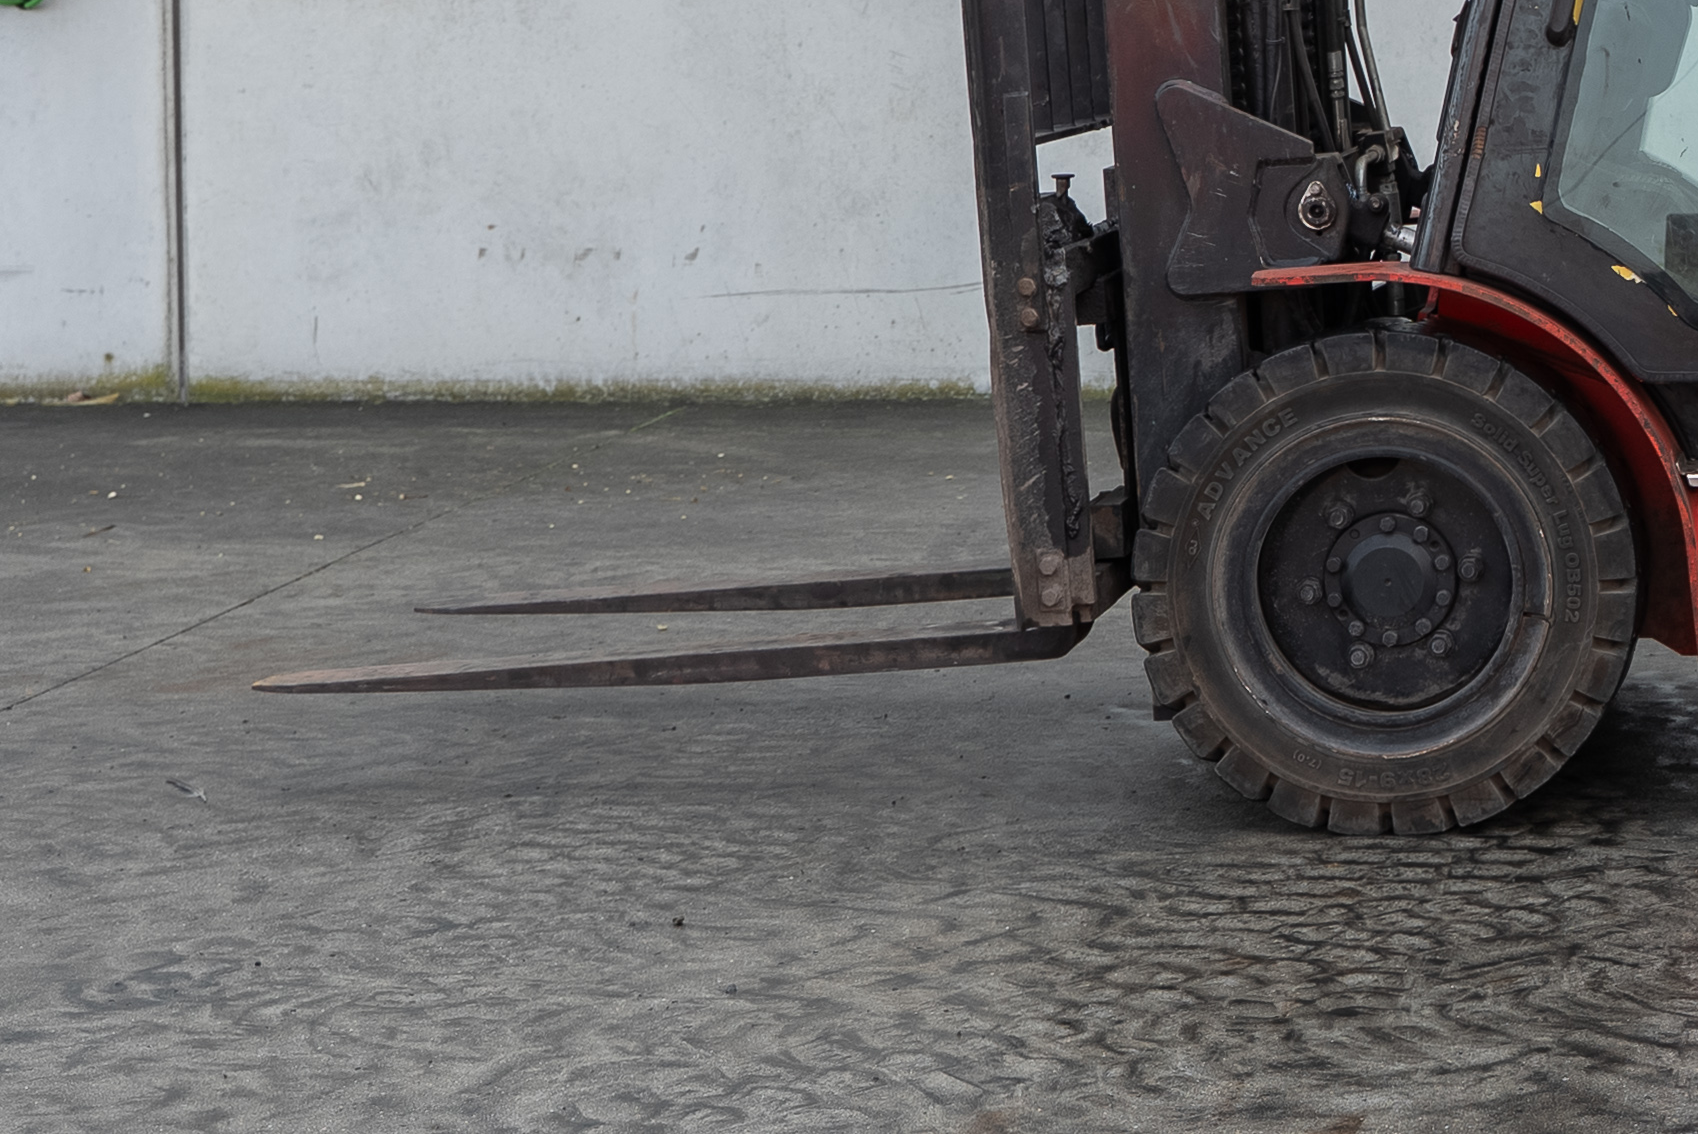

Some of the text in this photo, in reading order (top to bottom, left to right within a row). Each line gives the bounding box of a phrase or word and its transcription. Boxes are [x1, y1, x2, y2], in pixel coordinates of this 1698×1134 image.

[1197, 407, 1299, 522] ADVANCE
[1552, 509, 1573, 549] Lug
[1564, 552, 1582, 623] OB502
